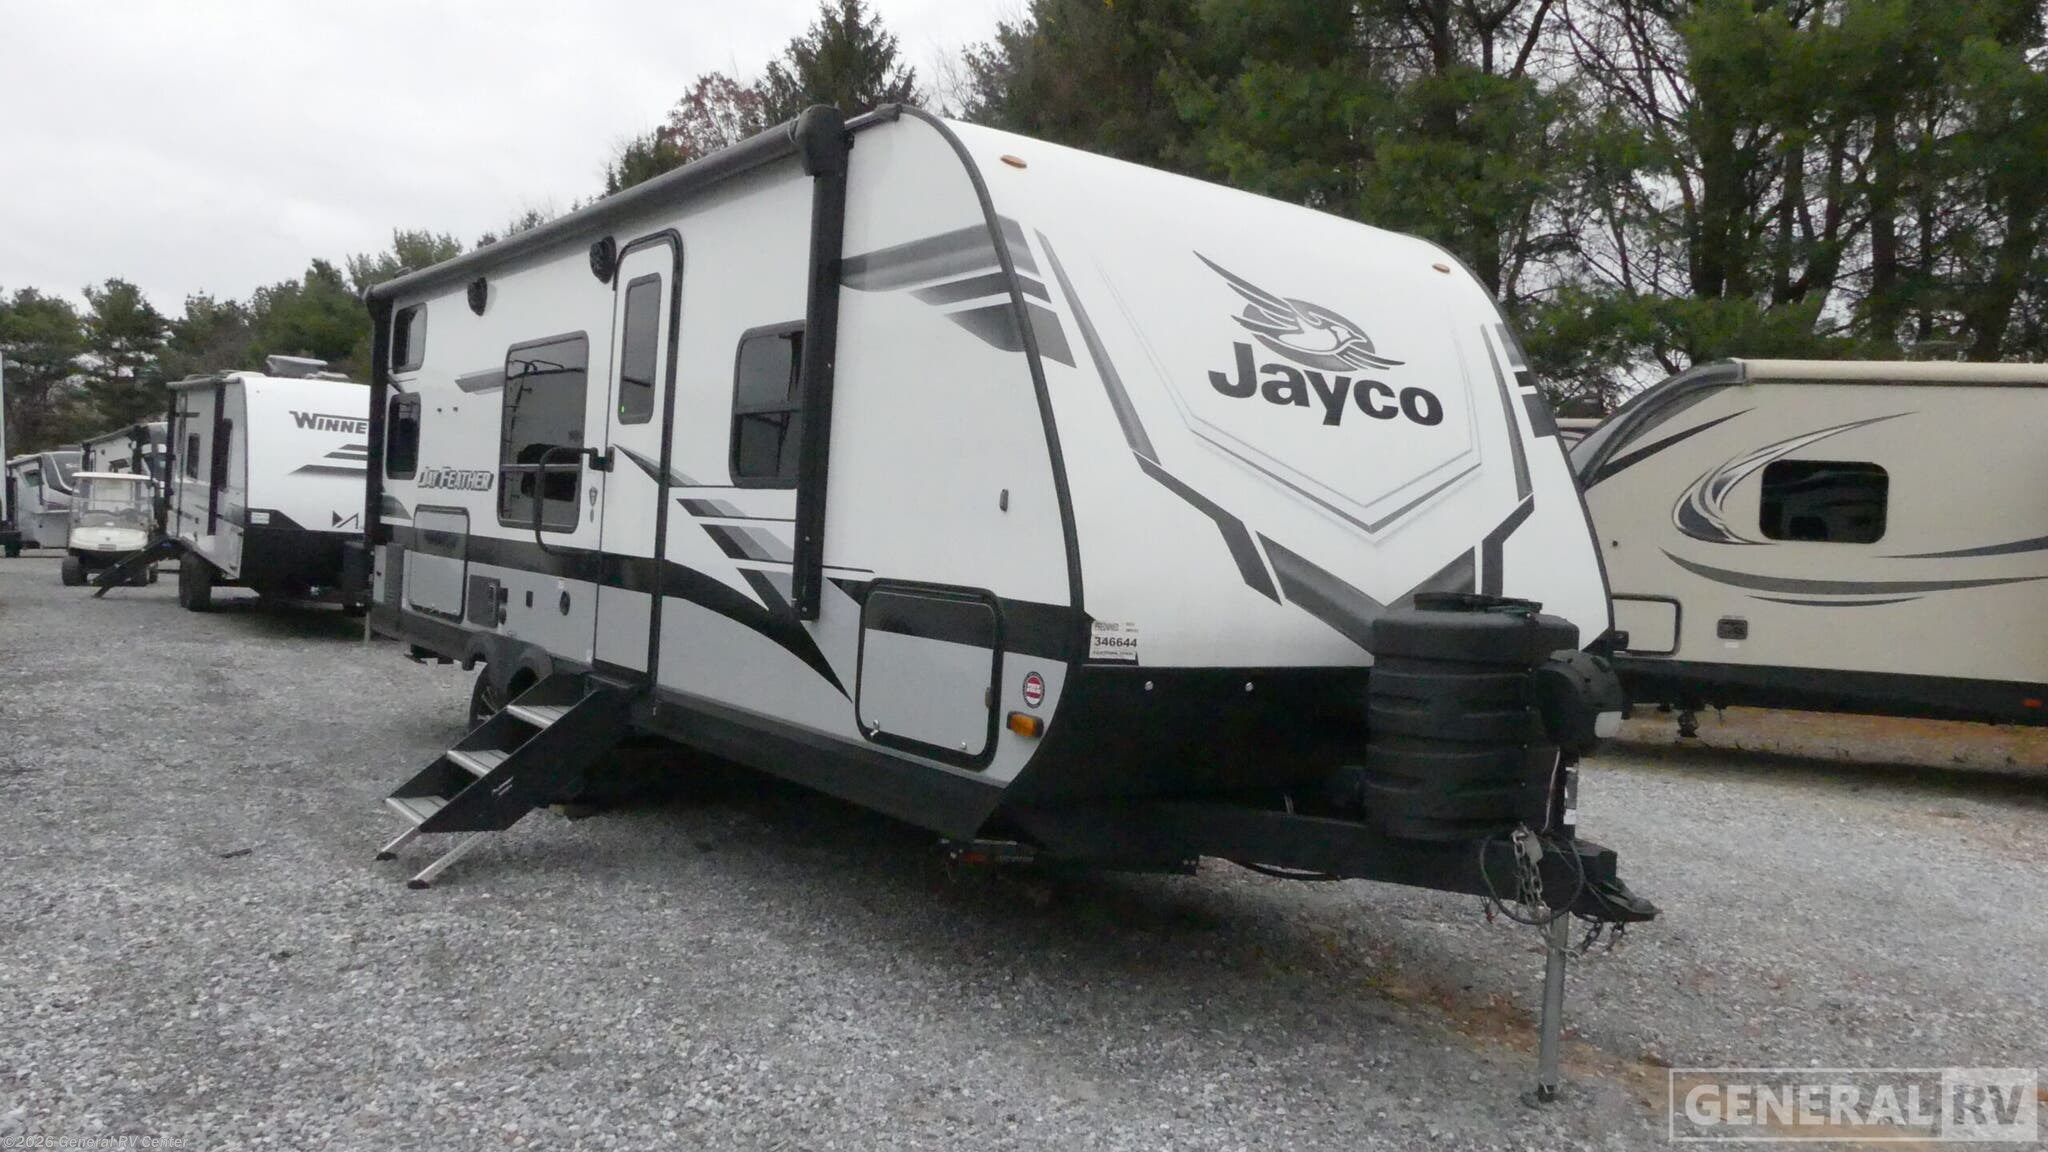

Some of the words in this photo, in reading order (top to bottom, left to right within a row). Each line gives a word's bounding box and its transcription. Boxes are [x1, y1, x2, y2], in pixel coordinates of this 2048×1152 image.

[1208, 341, 1444, 427] Jayco
[440, 466, 494, 491] FEATHER
[1094, 636, 1137, 648] 346644
